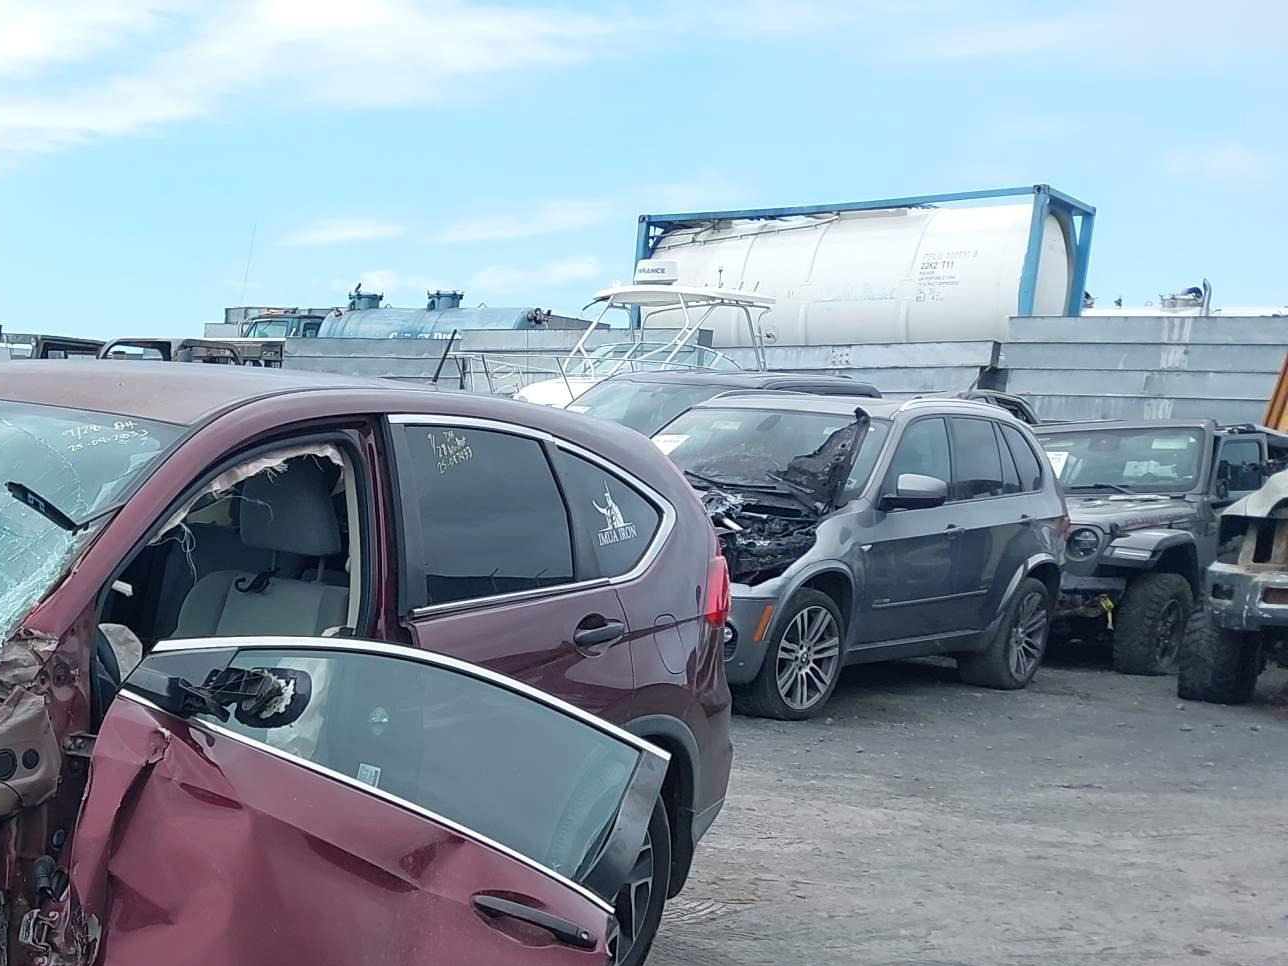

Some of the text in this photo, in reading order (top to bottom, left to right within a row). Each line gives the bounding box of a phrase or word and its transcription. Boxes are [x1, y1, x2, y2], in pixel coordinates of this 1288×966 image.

[920, 261, 938, 270] 22K2
[598, 525, 638, 546] IMUA IRON
